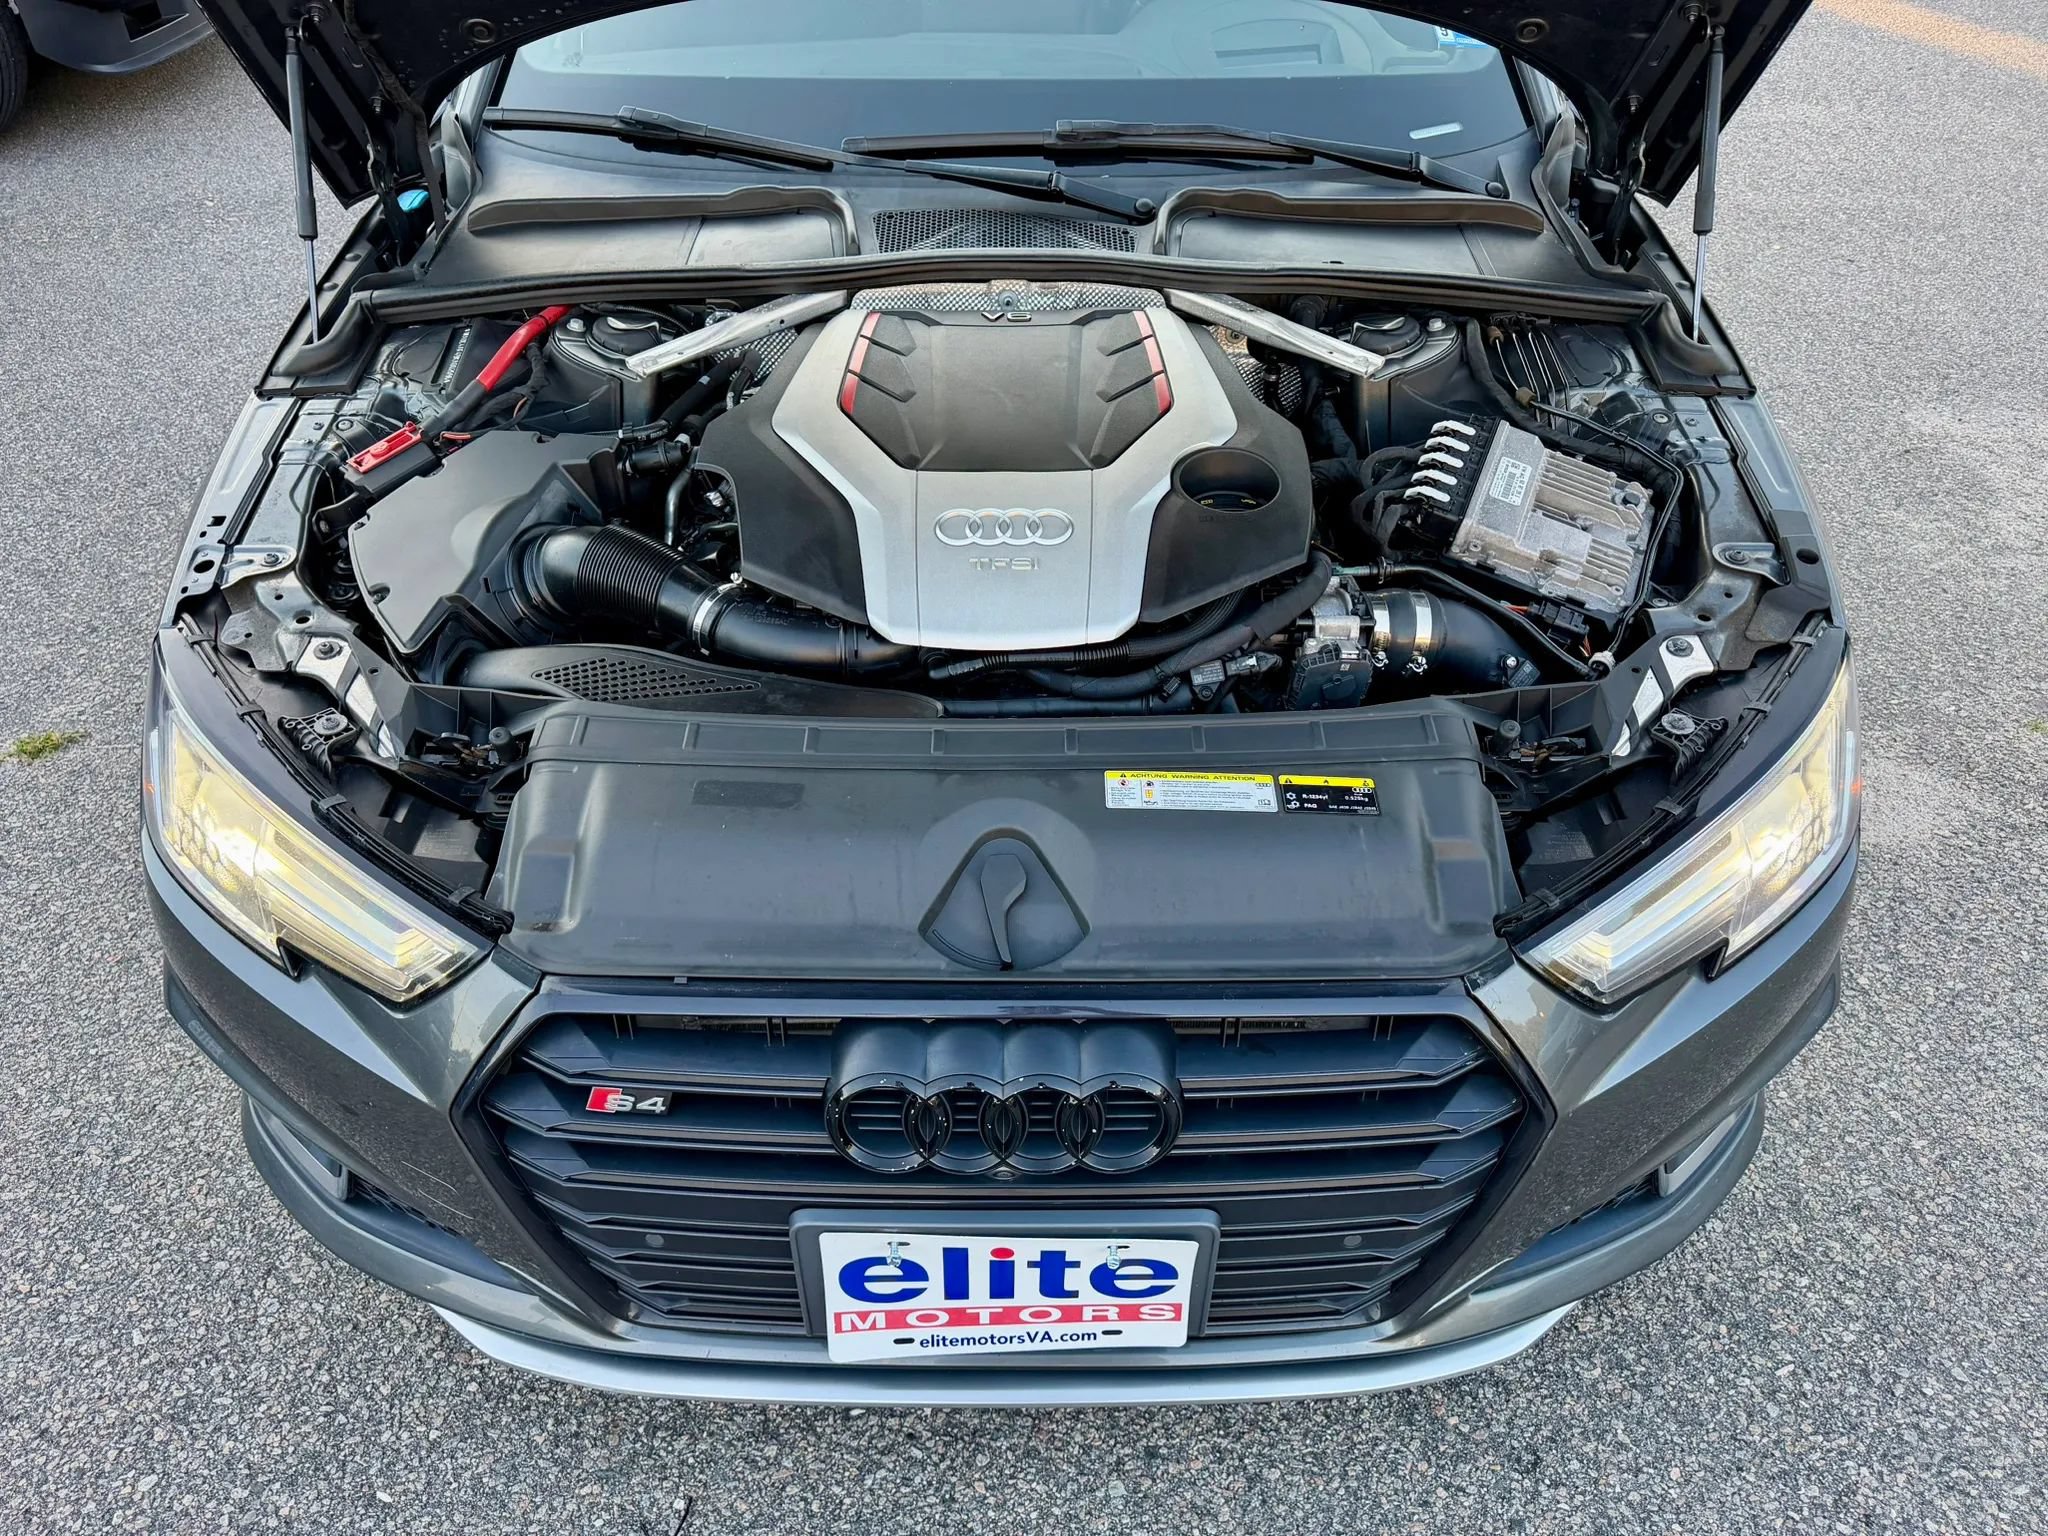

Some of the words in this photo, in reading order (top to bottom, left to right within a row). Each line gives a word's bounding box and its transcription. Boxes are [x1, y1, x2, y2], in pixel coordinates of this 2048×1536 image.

[981, 311, 1032, 322] V6
[968, 557, 1039, 570] TFSI
[604, 1092, 667, 1113] S4
[838, 1246, 1179, 1303] elite
[840, 1303, 1177, 1332] MOTORS
[919, 1330, 1097, 1349] elitemotorsVA.com
